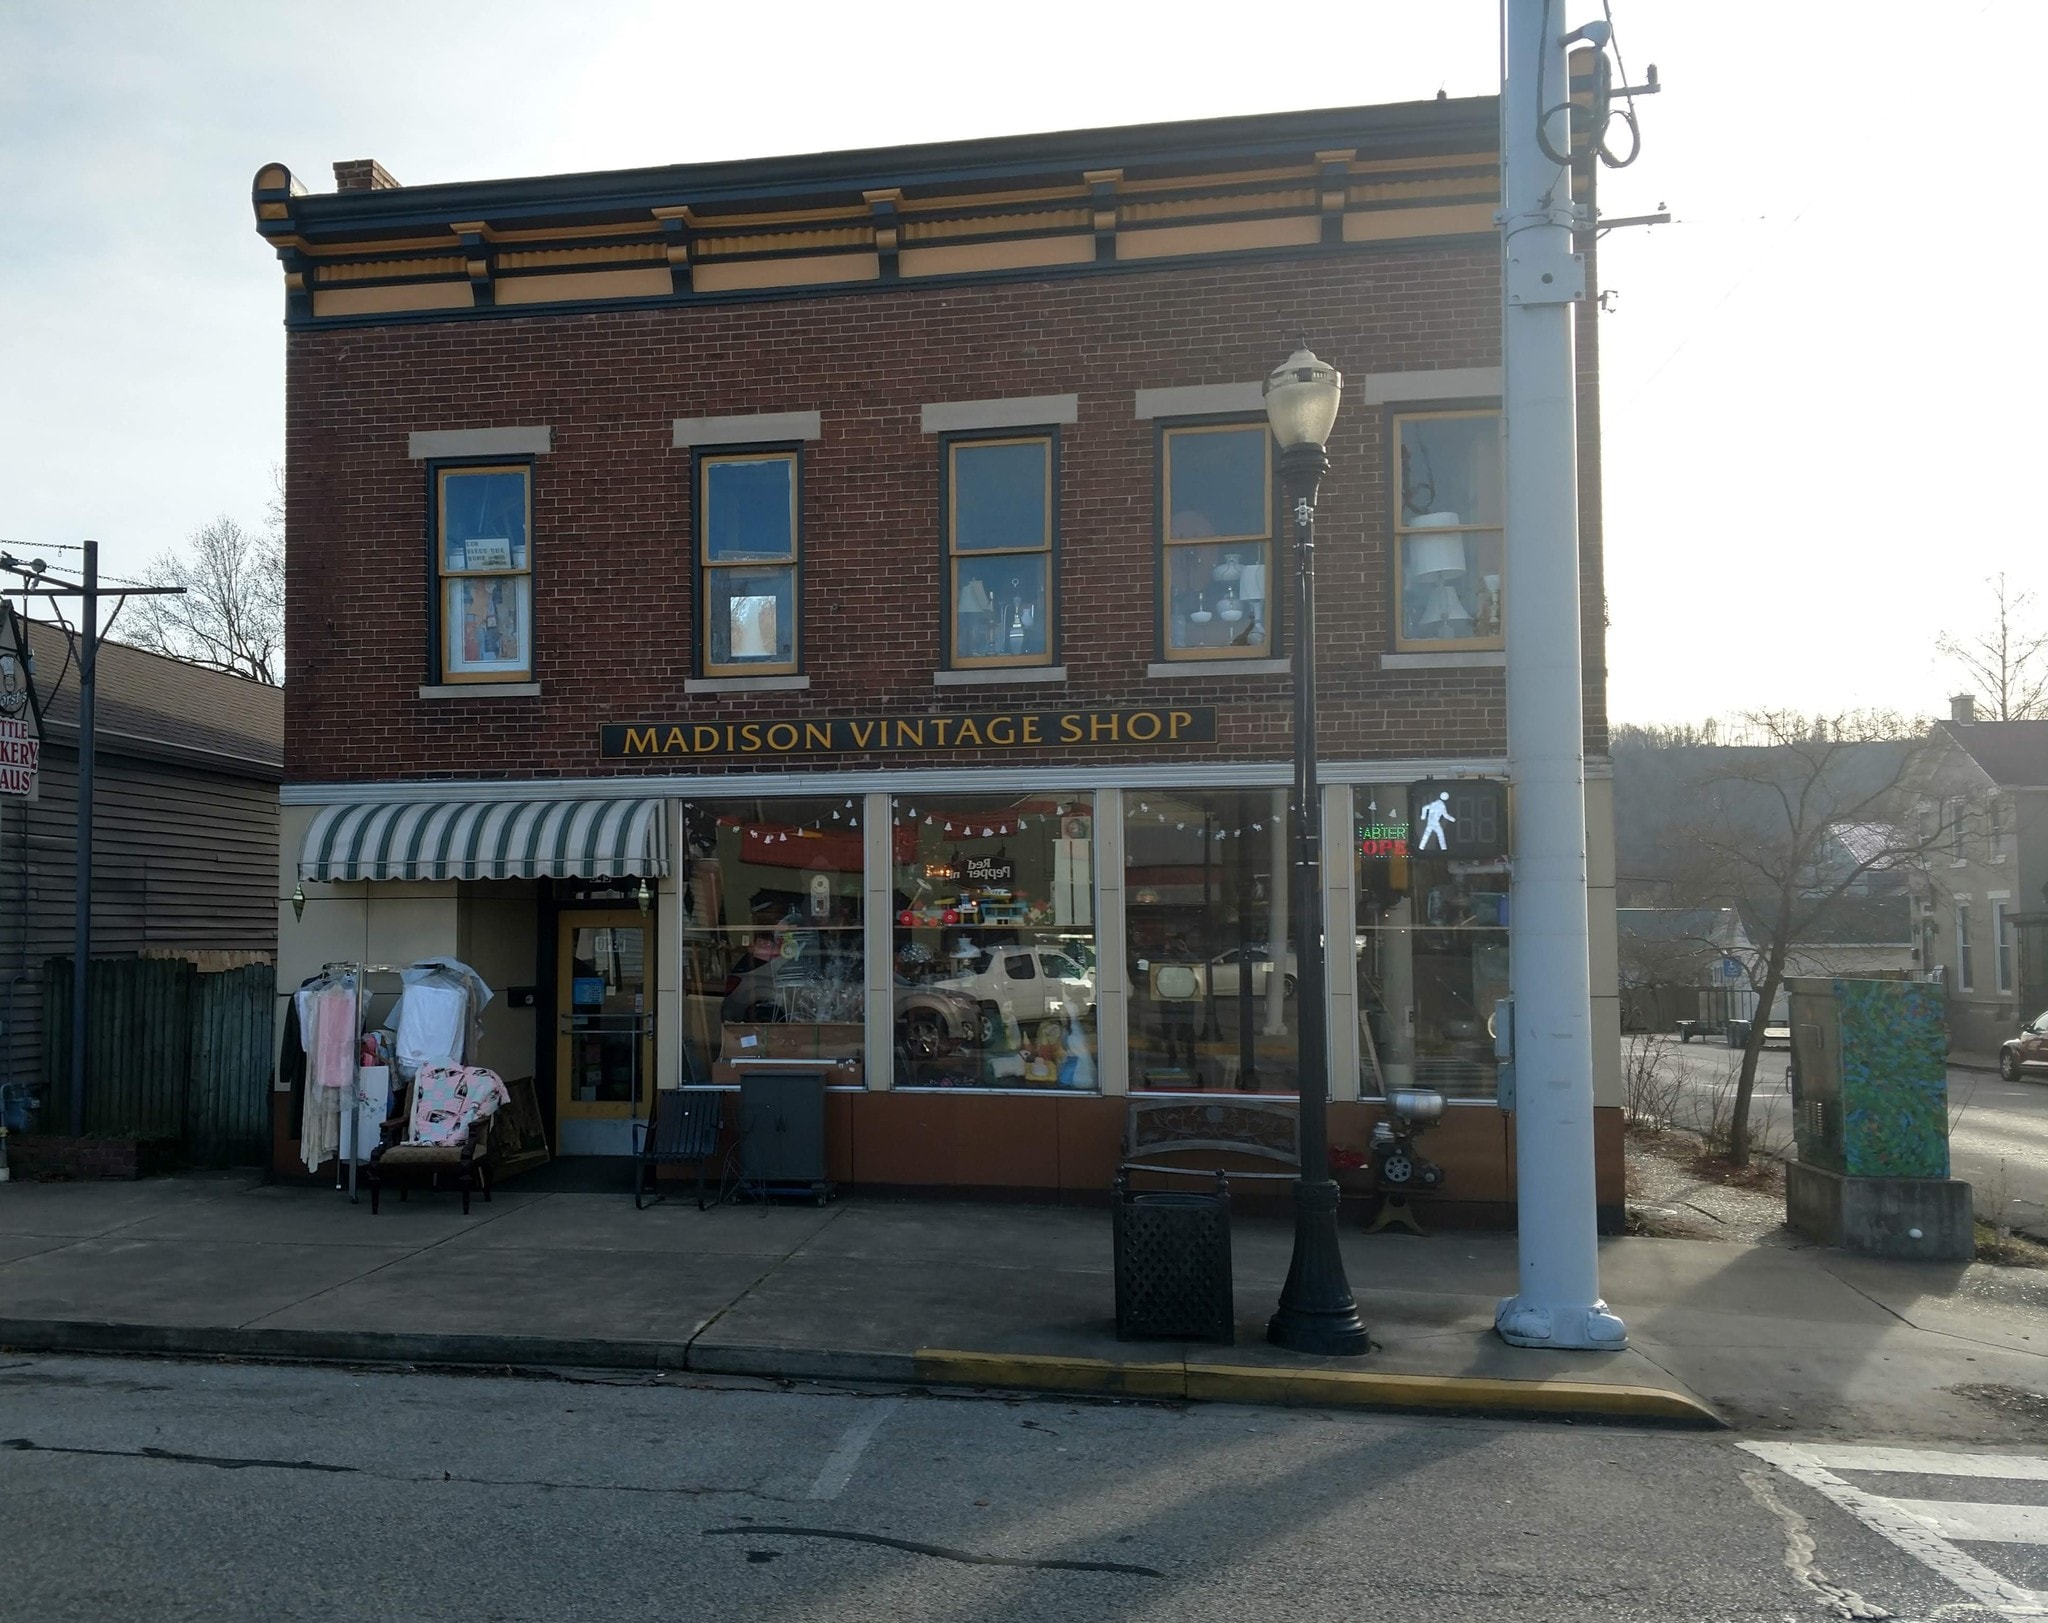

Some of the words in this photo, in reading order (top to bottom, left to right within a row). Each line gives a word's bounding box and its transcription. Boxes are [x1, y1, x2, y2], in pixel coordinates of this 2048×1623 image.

[623, 722, 831, 754] MADISON
[849, 716, 1042, 748] VINTAGE
[1060, 711, 1192, 742] SHOP
